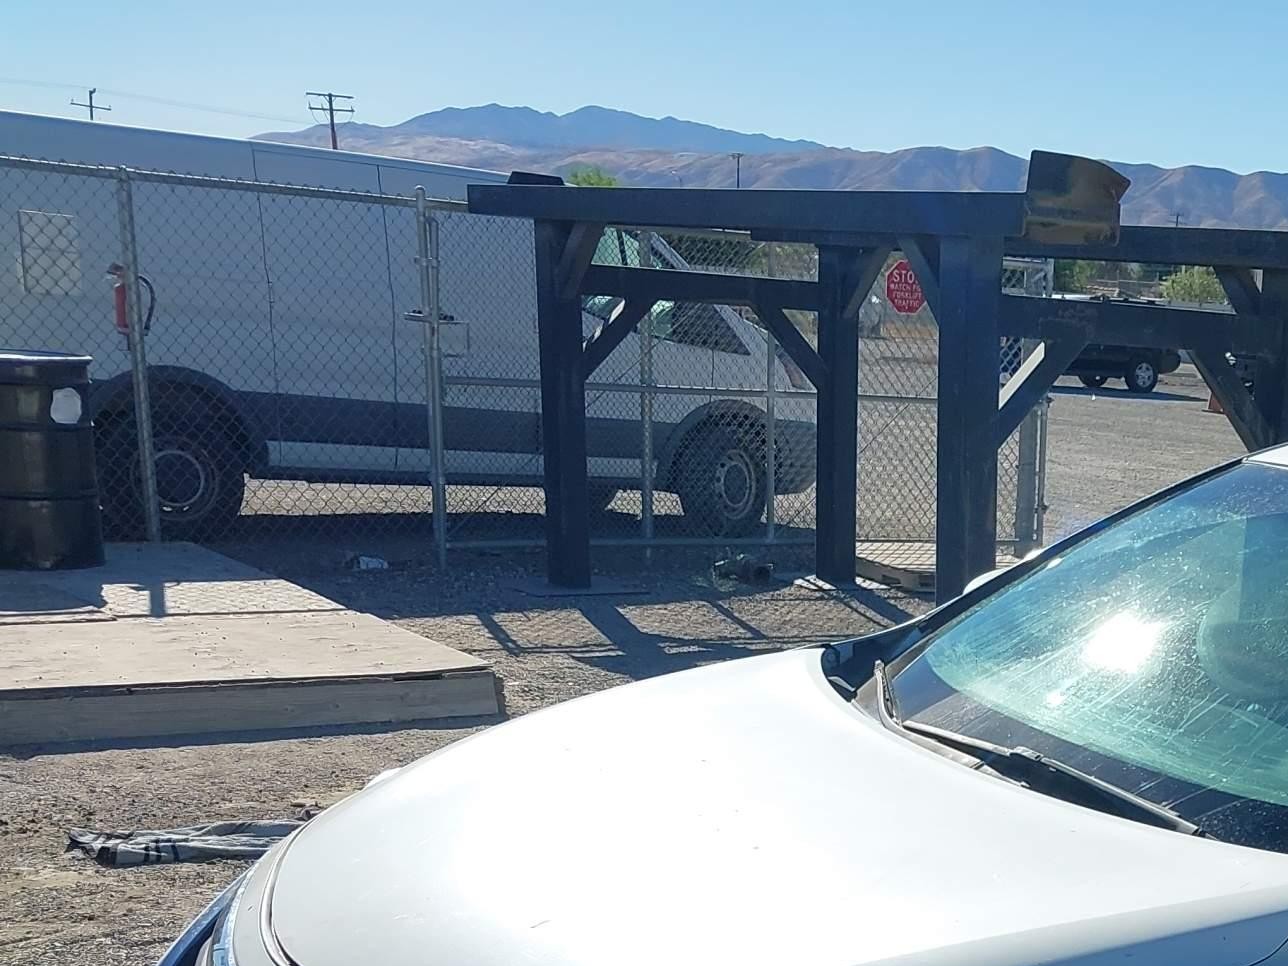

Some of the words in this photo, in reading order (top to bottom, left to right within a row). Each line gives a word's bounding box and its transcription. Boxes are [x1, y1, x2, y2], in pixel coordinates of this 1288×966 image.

[893, 269, 918, 284] STO
[893, 290, 922, 300] FORKLIFT
[894, 299, 920, 307] TRAFFIC
